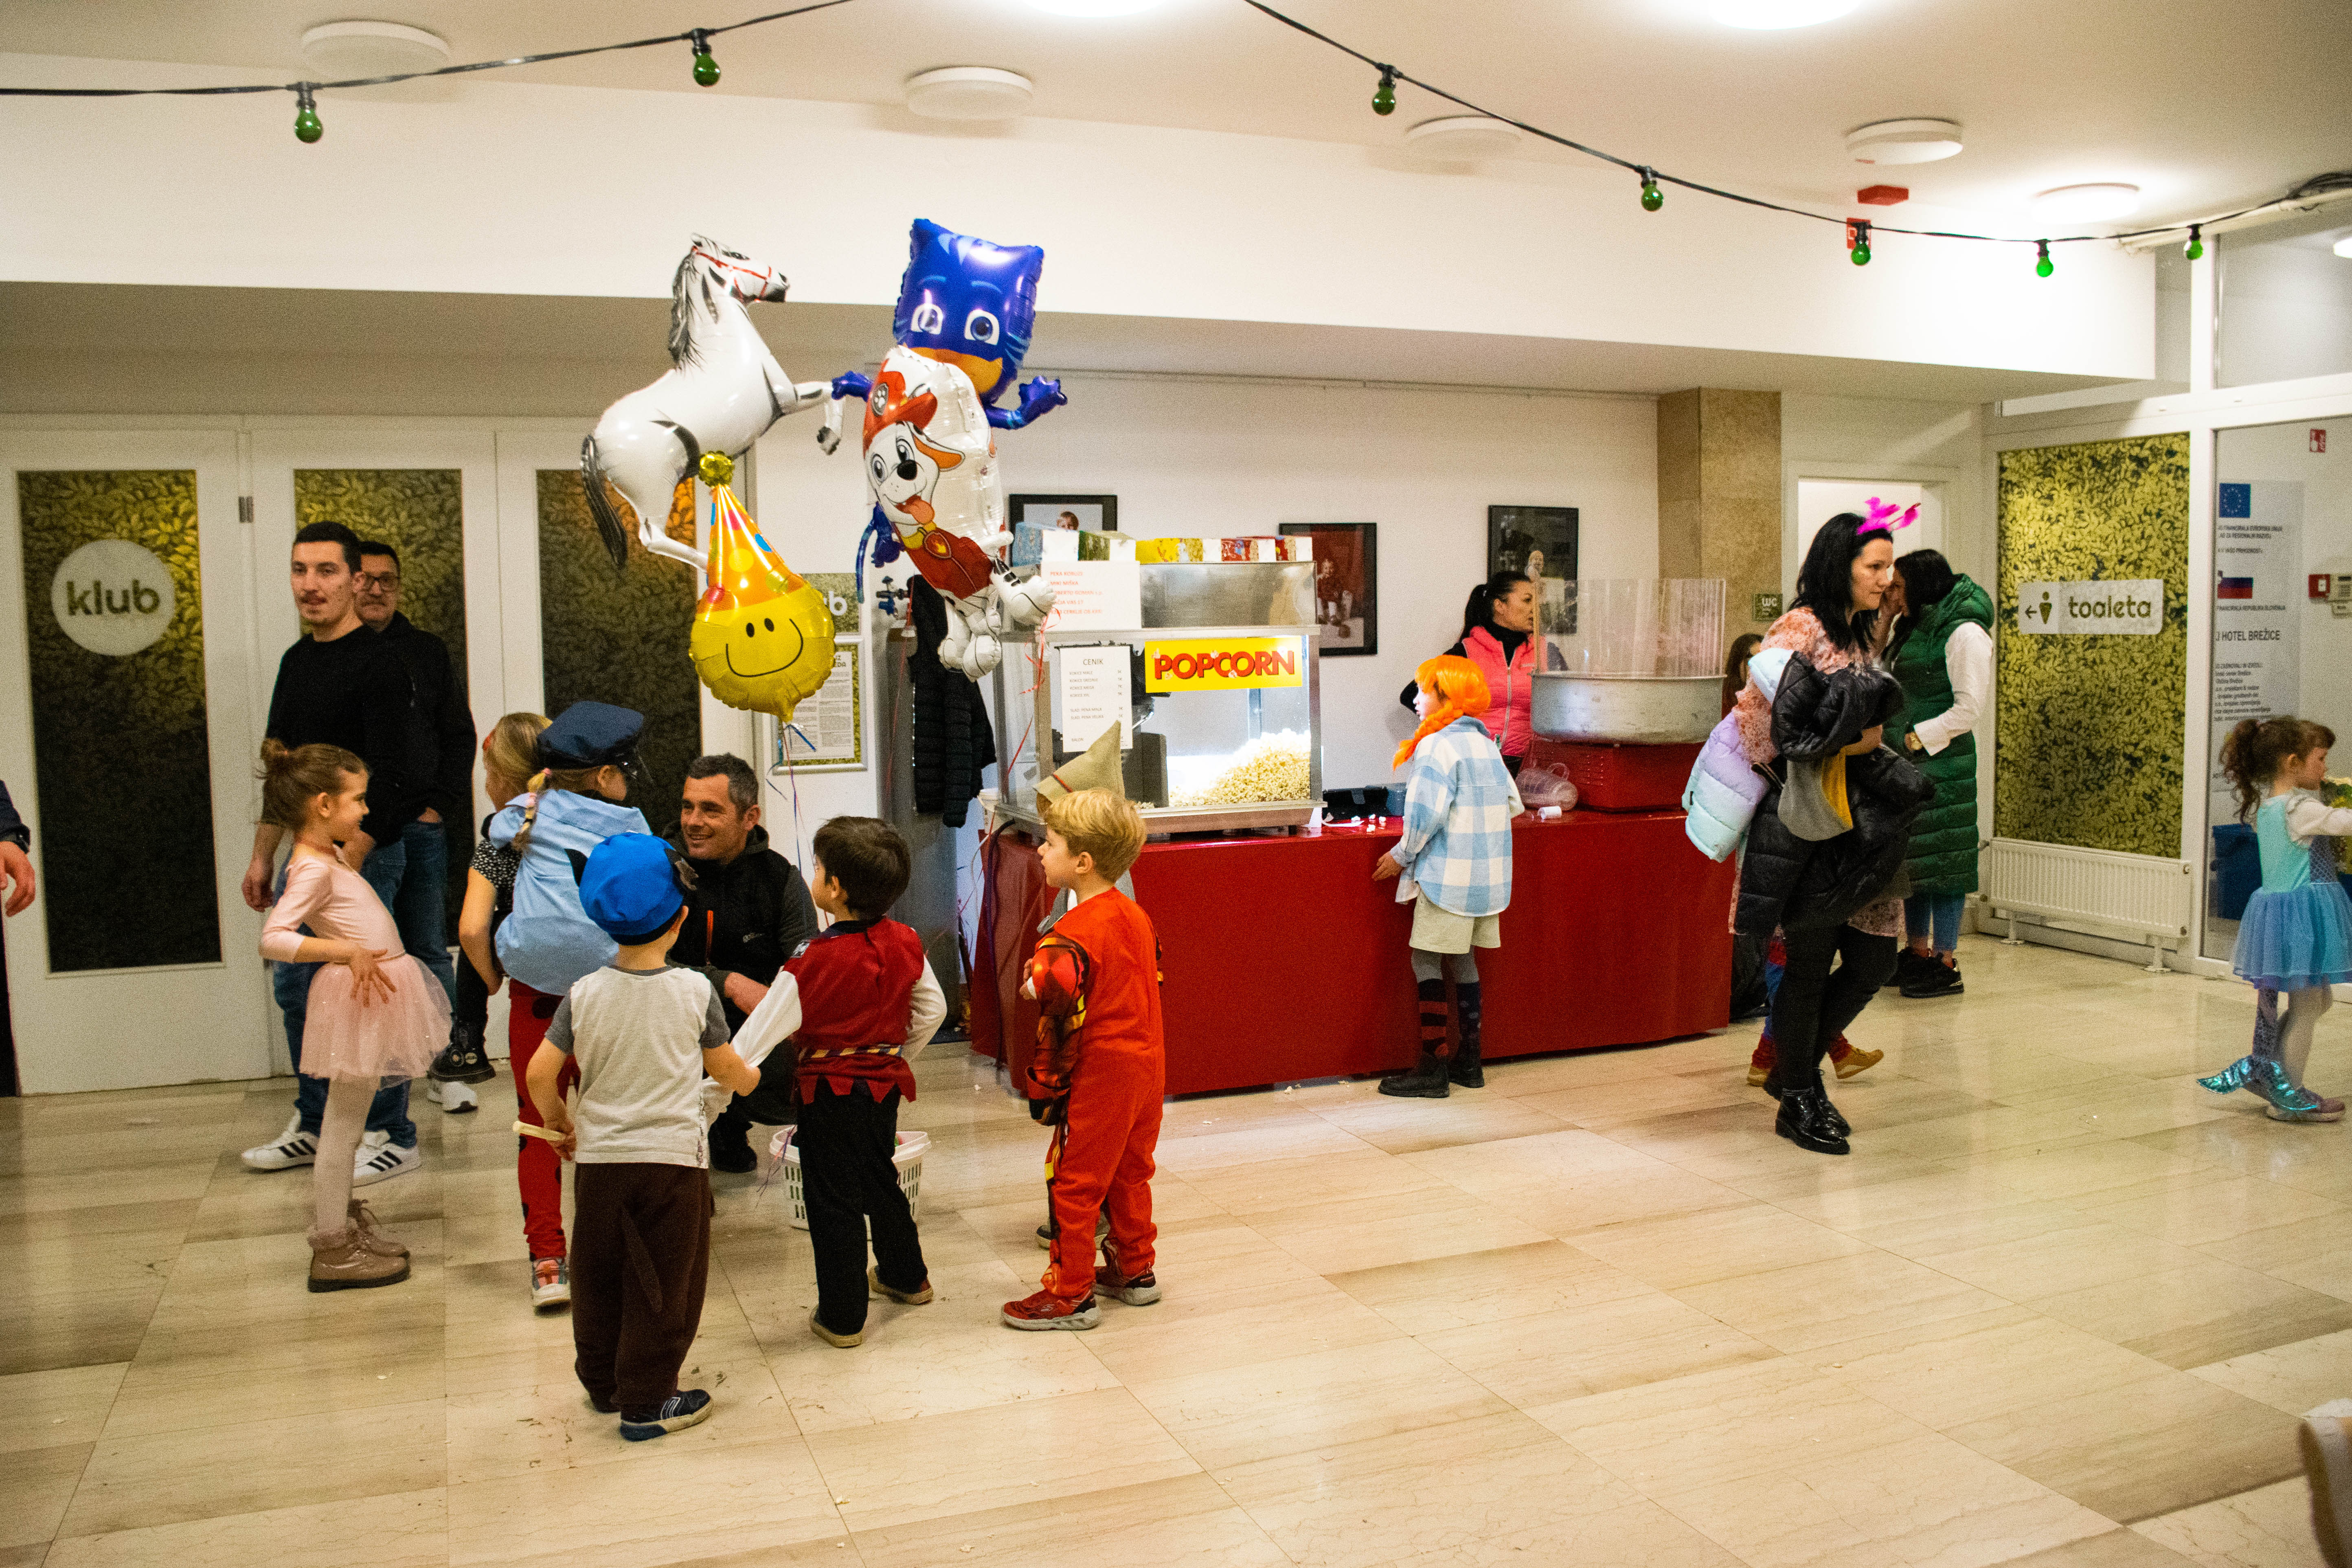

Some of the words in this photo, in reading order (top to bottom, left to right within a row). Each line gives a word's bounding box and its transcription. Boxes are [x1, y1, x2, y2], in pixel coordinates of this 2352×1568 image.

[66, 580, 160, 616] klub
[1762, 597, 1777, 607] WC
[2069, 595, 2151, 618] toaleta
[2222, 631, 2247, 641] HOTEL
[2248, 627, 2280, 640] BREŽICE
[1154, 650, 1294, 680] POPCORN
